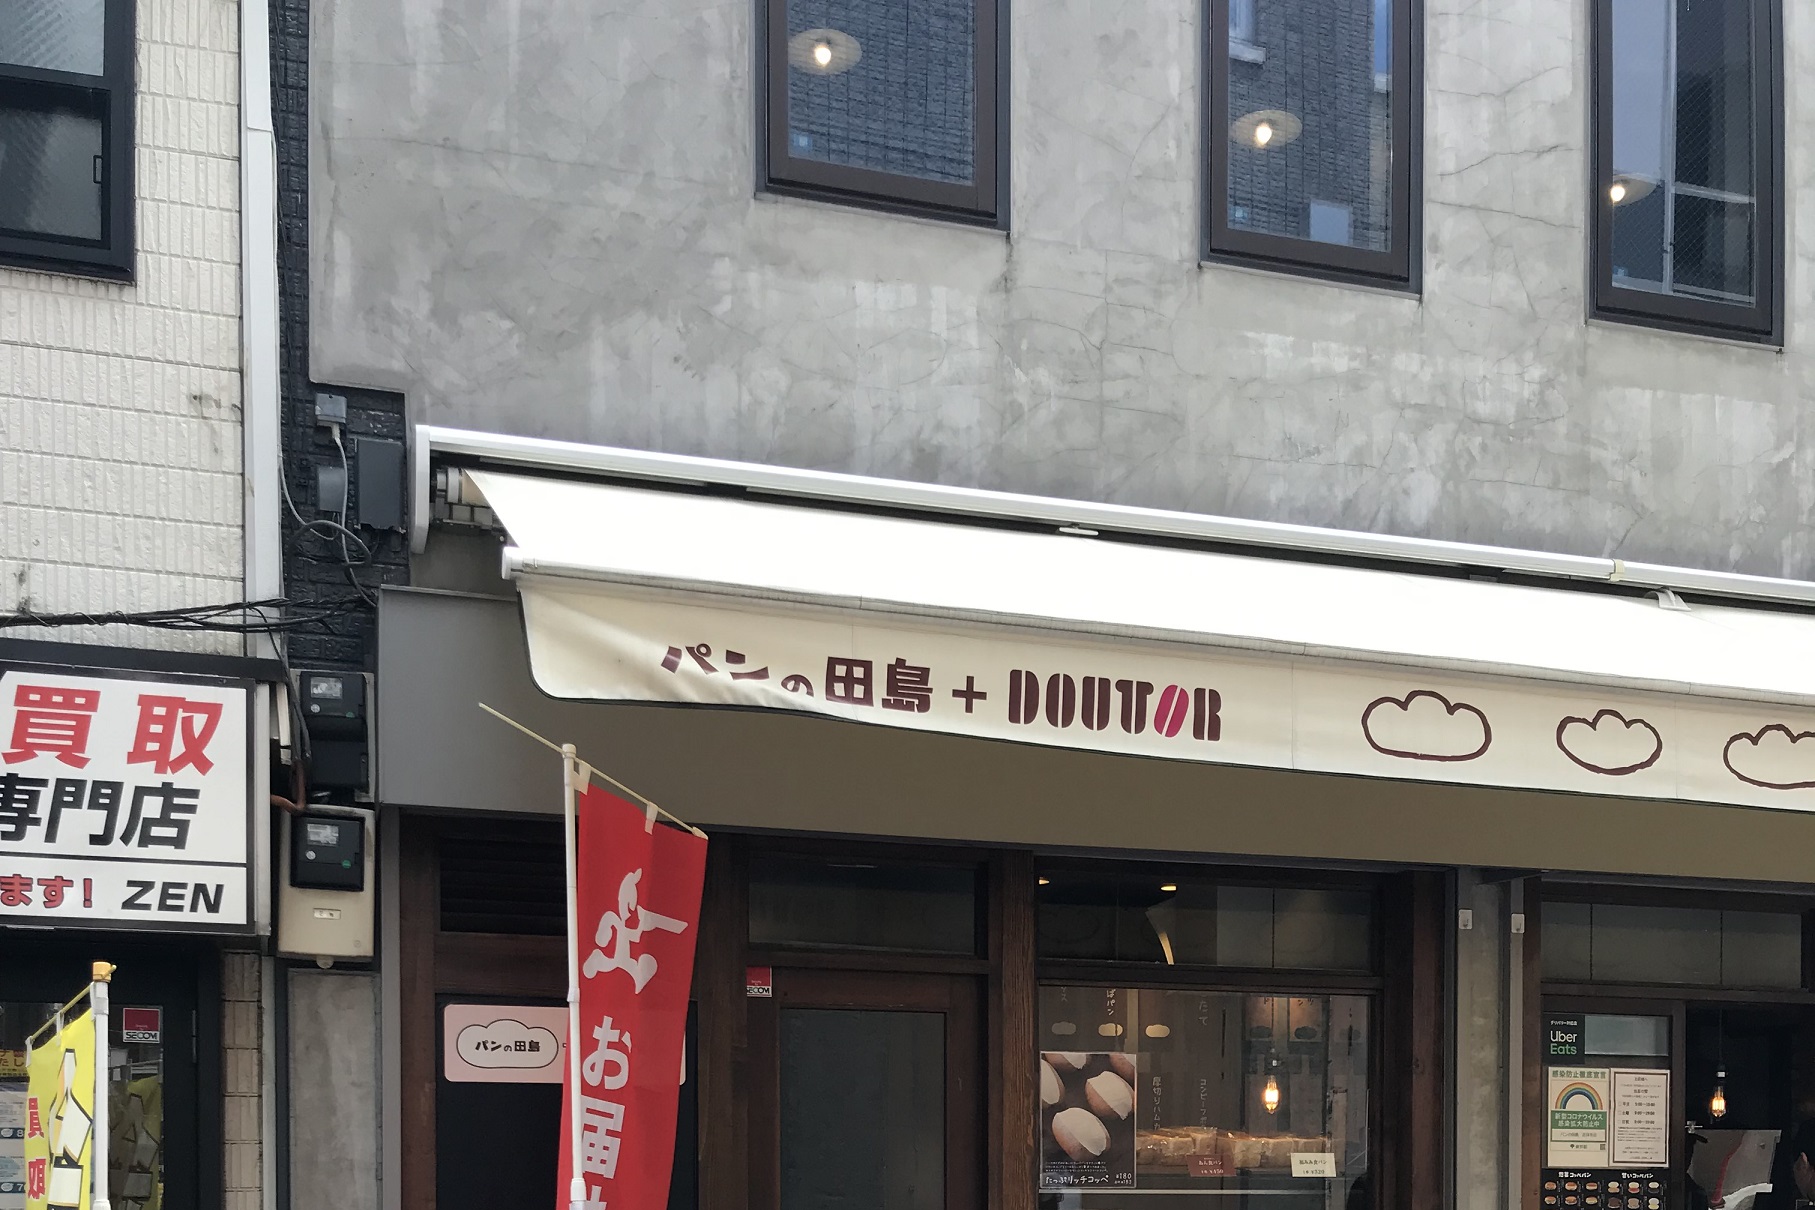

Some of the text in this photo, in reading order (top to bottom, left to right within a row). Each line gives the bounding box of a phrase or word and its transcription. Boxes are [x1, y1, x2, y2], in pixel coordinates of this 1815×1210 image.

[660, 642, 933, 713] パンの田島
[1009, 669, 1221, 742] DOUTOR
[1, 684, 224, 776] 買取
[0, 772, 200, 850] 専門店
[121, 879, 225, 914] ZEN
[125, 1031, 158, 1040] SECOM
[475, 1039, 541, 1053] パンの田島
[1550, 1030, 1578, 1043] Uber
[1550, 1043, 1577, 1055] Eats
